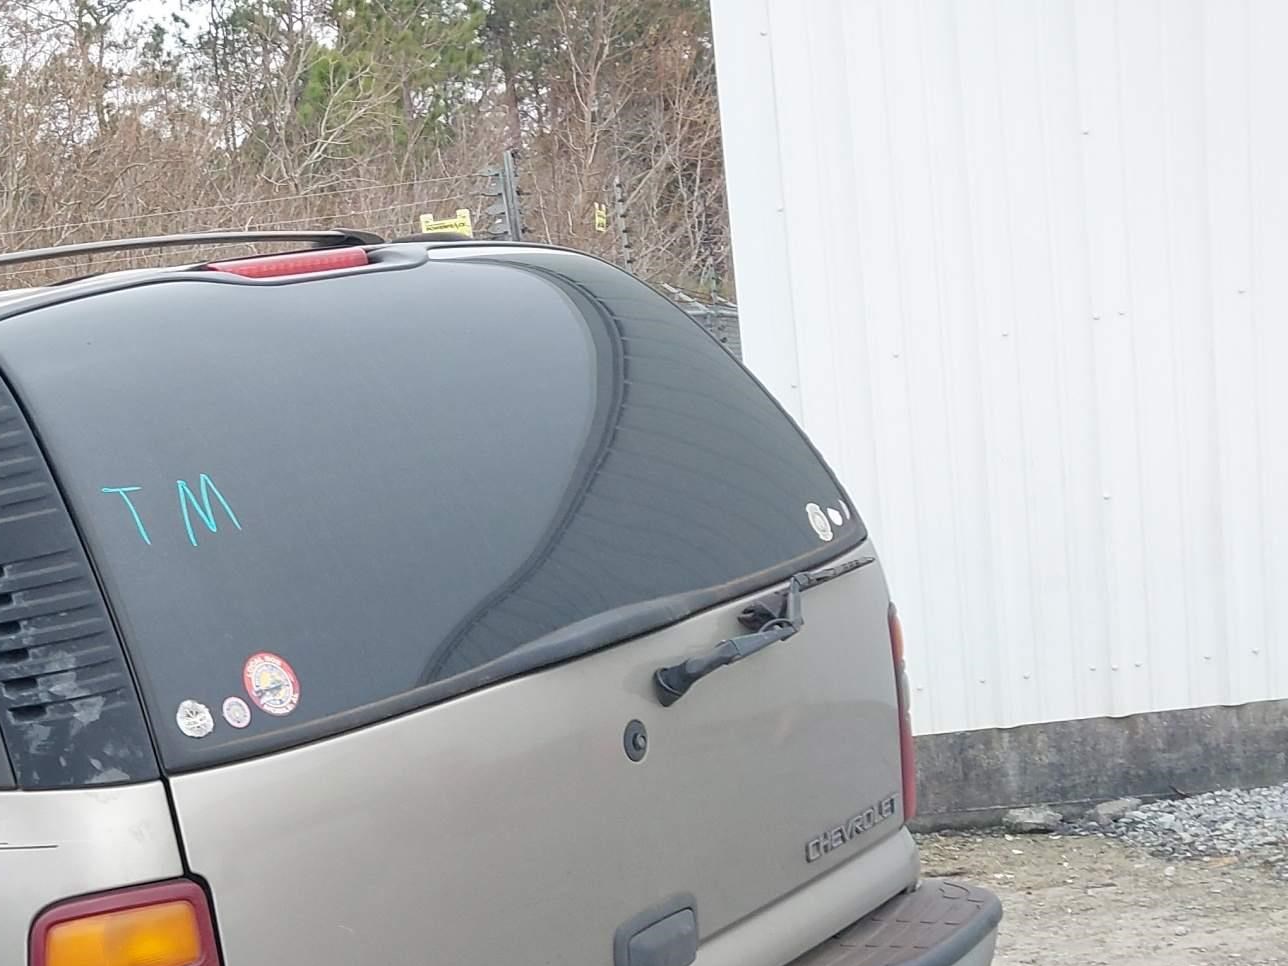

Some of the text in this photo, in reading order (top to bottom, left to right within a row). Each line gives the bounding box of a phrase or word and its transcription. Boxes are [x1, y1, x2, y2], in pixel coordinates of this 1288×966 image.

[102, 473, 242, 547] T M
[805, 793, 900, 863] CHEVROLET
